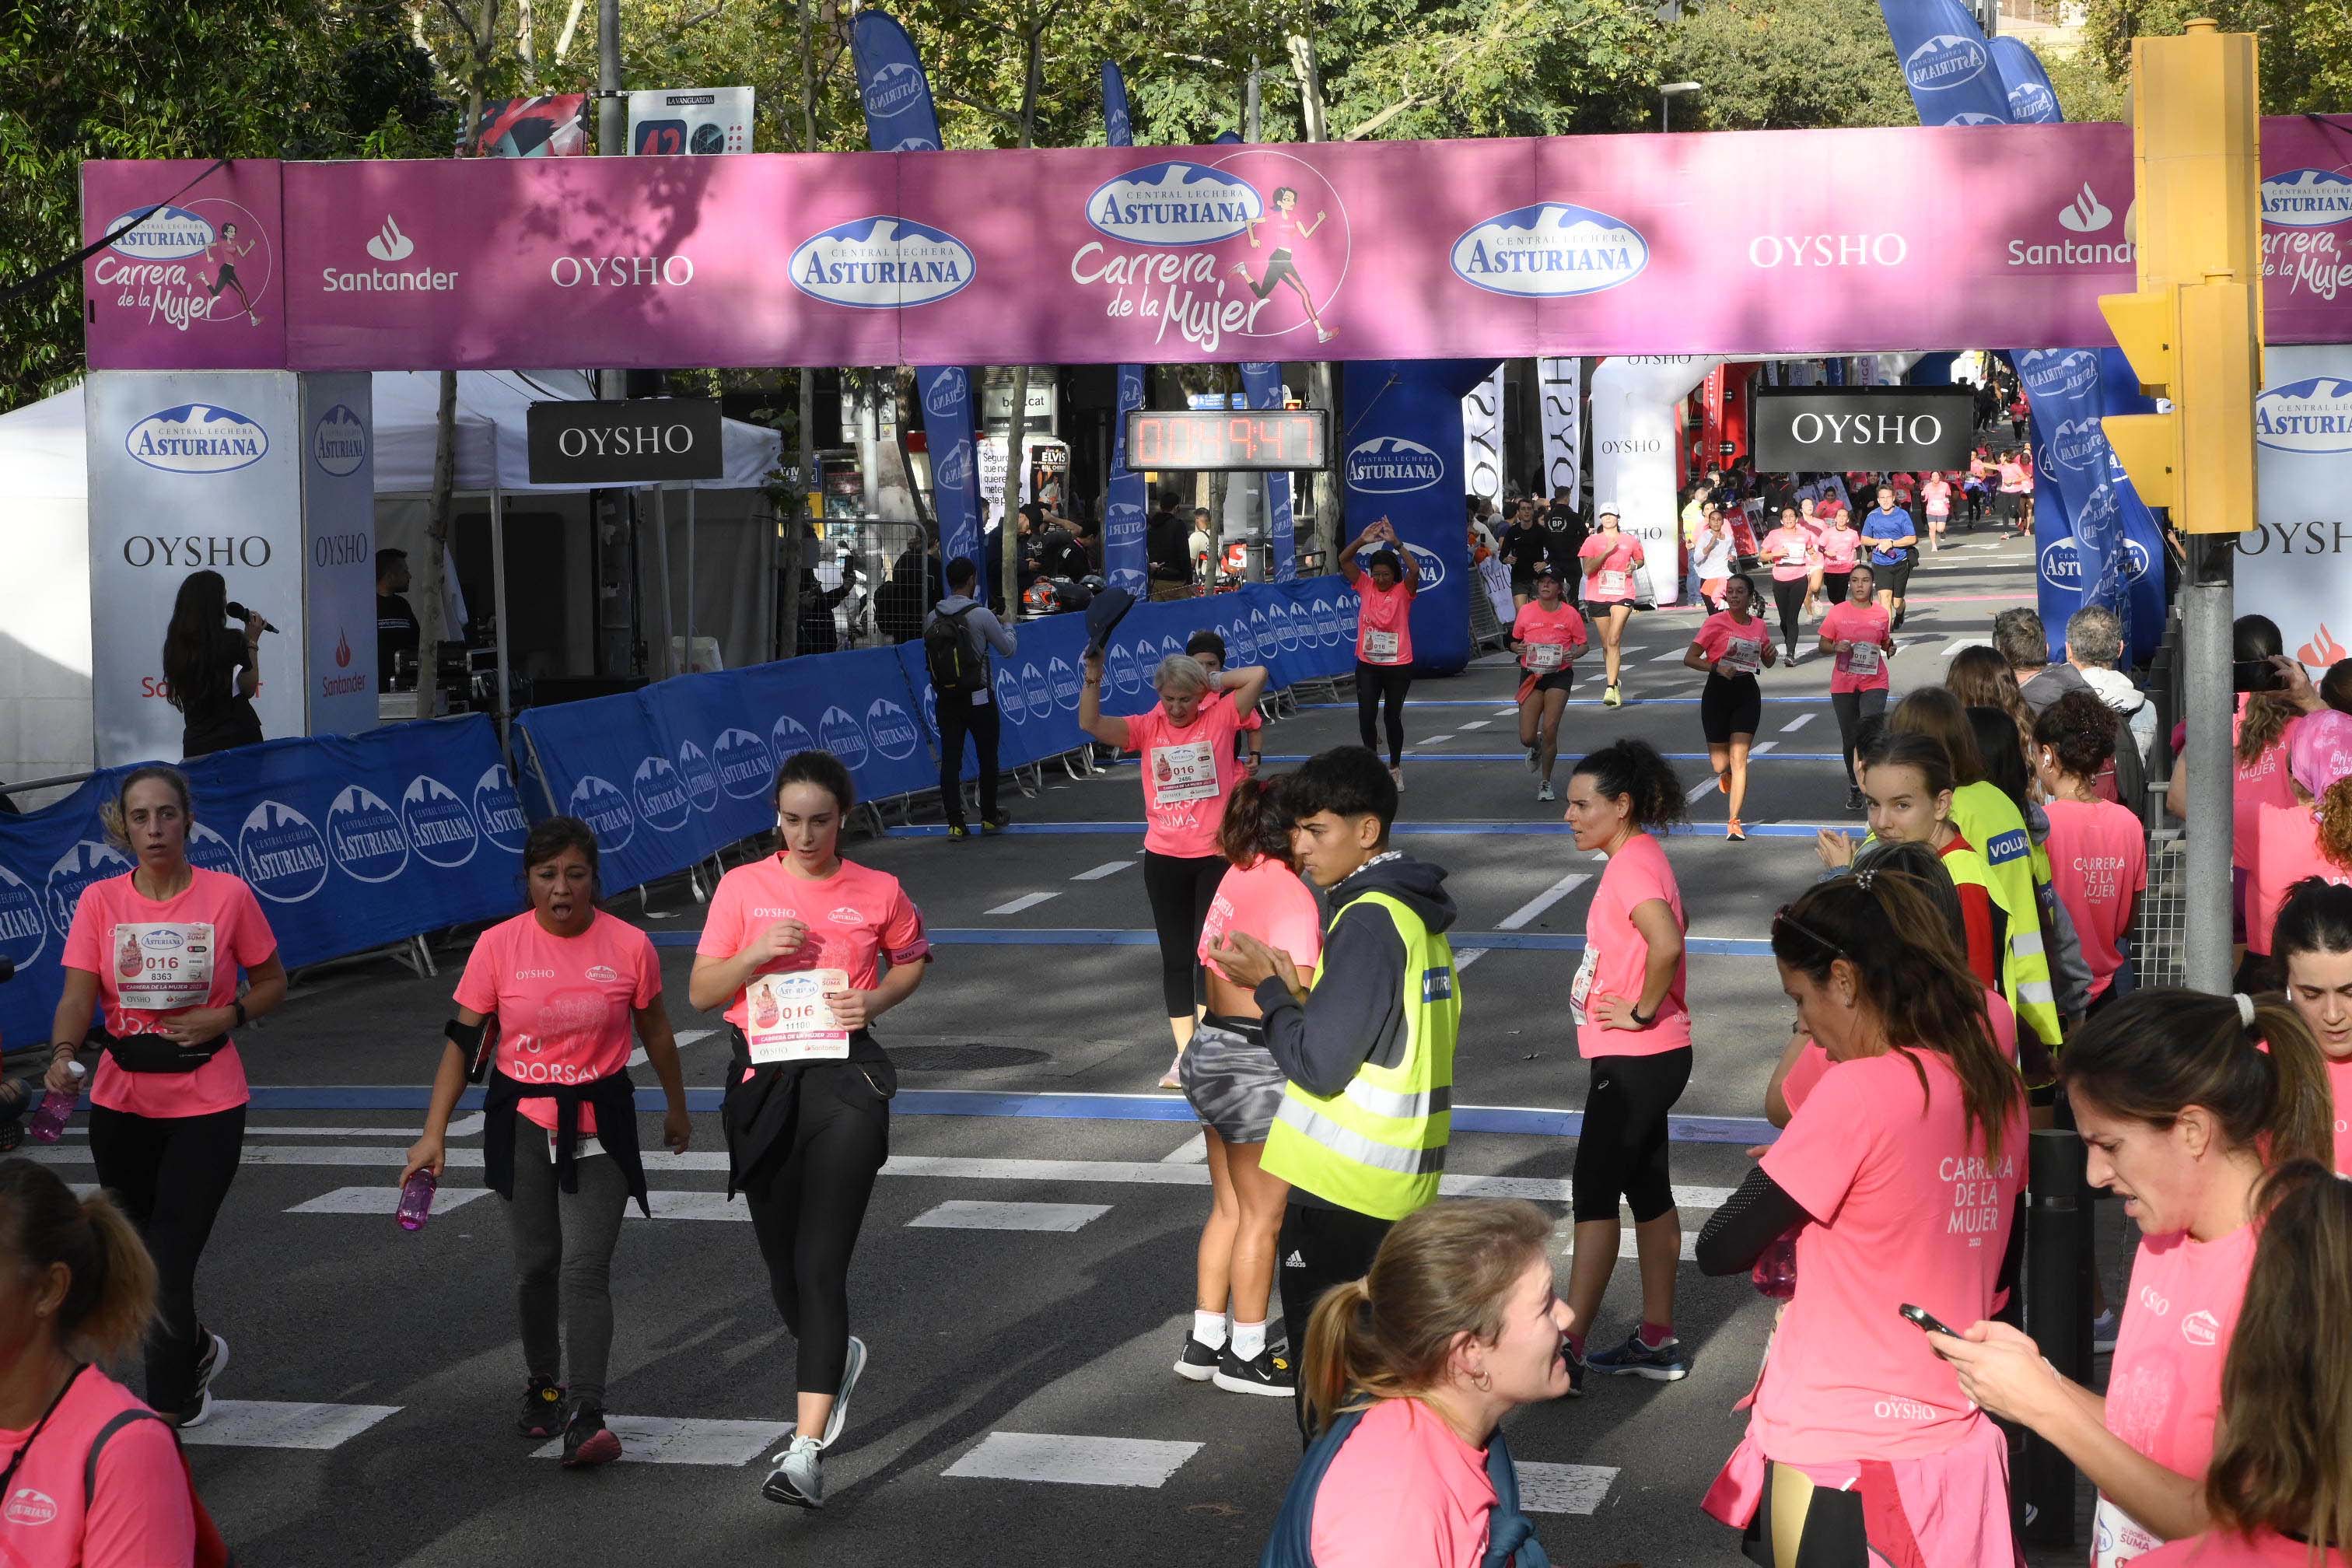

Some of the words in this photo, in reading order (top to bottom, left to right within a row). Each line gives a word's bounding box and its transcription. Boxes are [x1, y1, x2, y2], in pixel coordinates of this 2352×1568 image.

[676, 96, 714, 104] VANGUARDIA
[1127, 191, 1182, 199] CENTRAL
[1188, 189, 1244, 198] LECHERA
[1100, 194, 1248, 225] ASTURIANA
[831, 248, 888, 257] CENTRAL
[896, 247, 954, 257] LECHERA
[1496, 236, 1555, 246] CENTRAL
[1748, 233, 1907, 268] OYSHO
[2008, 240, 2138, 265] Santand
[2262, 232, 2335, 254] arrera
[803, 250, 962, 285] ASTURIANA
[1071, 242, 1216, 285] Carrera
[1466, 239, 1633, 274] ASTURIANA
[95, 257, 187, 285] Carrera
[323, 267, 459, 292] Santander
[550, 255, 694, 287] OYSHO
[2280, 255, 2293, 276] la
[2290, 250, 2352, 300] Muje
[118, 286, 134, 306] de
[138, 286, 150, 306] la
[149, 283, 221, 331] Mujer
[1107, 287, 1133, 317] de
[1139, 286, 1159, 317] la
[1156, 279, 1271, 352] Mujer
[2277, 403, 2330, 412] CENTRAL
[559, 425, 693, 457] OYSHO
[1791, 413, 1941, 445] OYSHO
[137, 430, 258, 456] ASTURIANA
[318, 428, 362, 460] ASTURIANA
[1601, 439, 1661, 454] OYSHO
[1042, 452, 1065, 462] ELVIS
[984, 466, 996, 475] que
[1349, 460, 1437, 481] ASTURIANA
[1552, 520, 1563, 528] BP
[123, 536, 271, 567] OYSHO
[316, 532, 368, 568] OYSHO
[323, 672, 366, 698] Santander
[717, 754, 772, 786] ASTURIANA
[1174, 766, 1194, 775] 016
[2261, 753, 2274, 765] LA
[2238, 763, 2275, 782] MUJER
[408, 811, 474, 848] ASTURIANA
[334, 824, 405, 863] ASTURIANA
[247, 842, 324, 883] ASTURIANA
[2073, 856, 2125, 871] CARRERA
[2101, 870, 2114, 884] LA
[754, 908, 796, 918] OYSHO
[146, 957, 179, 969] 016
[516, 969, 555, 980] OYSHO
[782, 1005, 814, 1020] 016
[516, 1034, 542, 1053] TU
[760, 1048, 788, 1056] OYSHO
[1955, 1182, 1976, 1207] DE
[1981, 1181, 1997, 1206] LA
[1948, 1208, 1997, 1234] MUJER
[1874, 1402, 1936, 1419] OYSHO
[2120, 1534, 2150, 1551] SUMA
